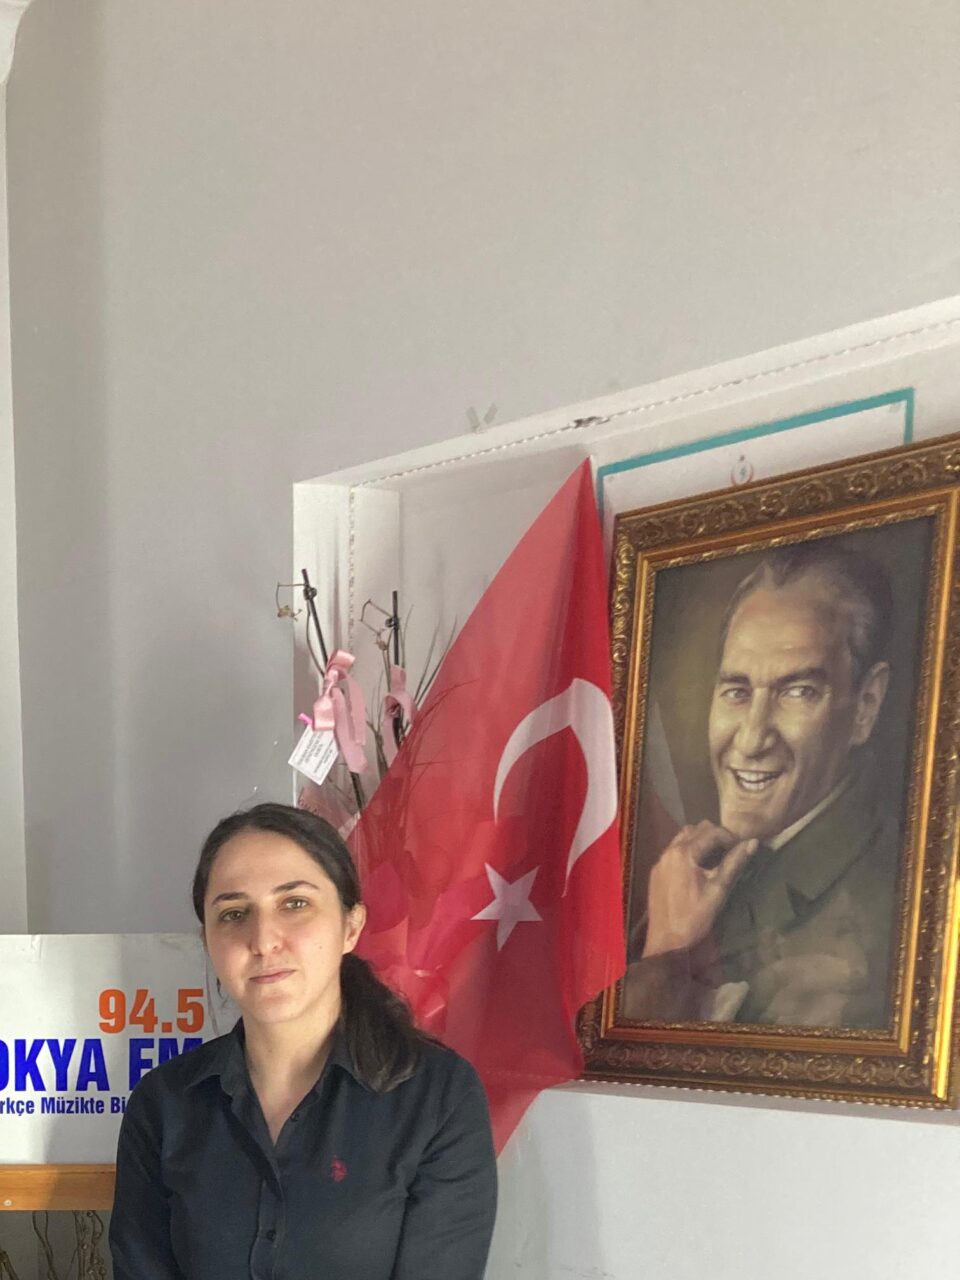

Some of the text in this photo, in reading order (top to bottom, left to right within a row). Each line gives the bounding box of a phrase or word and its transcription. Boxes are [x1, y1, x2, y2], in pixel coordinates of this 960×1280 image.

[98, 988, 205, 1034] 94.5
[41, 1096, 104, 1114] Müzikte
[110, 1096, 127, 1114] Bi
